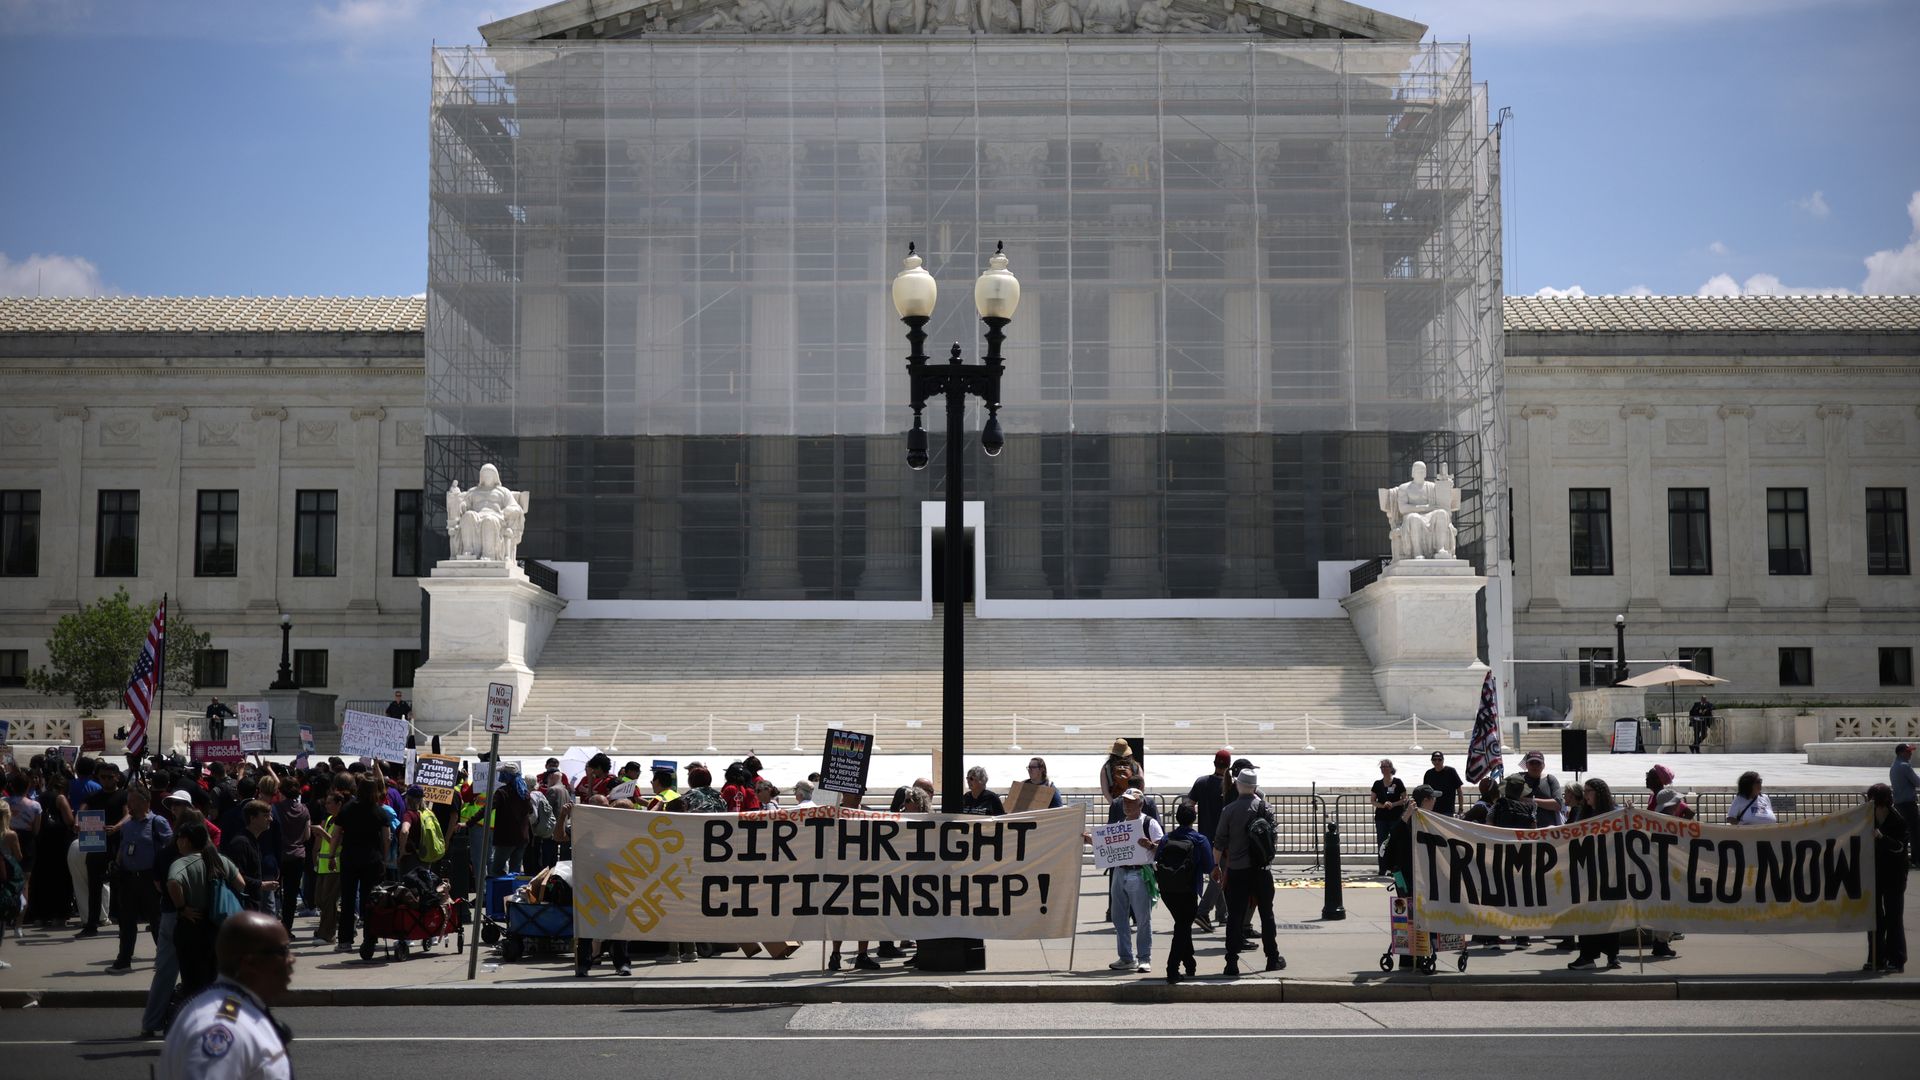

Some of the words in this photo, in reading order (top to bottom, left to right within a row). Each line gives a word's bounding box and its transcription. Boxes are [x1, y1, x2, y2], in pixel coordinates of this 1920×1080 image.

[496, 687, 505, 696] NO
[490, 696, 509, 707] PARKING
[492, 715, 503, 723] TIME
[374, 738, 405, 751] UPHOLD
[832, 731, 866, 759] NO!
[421, 763, 454, 774] Trump
[836, 762, 861, 772] Humanity
[418, 769, 455, 780] Fascist
[835, 774, 853, 782] Accept
[839, 769, 860, 777] REFUSE
[416, 776, 453, 787] Regime
[823, 777, 840, 786] Fascist
[841, 780, 862, 789] America
[1106, 824, 1134, 835] PEOPLE
[703, 817, 1037, 863] BIRTHRIGHT
[1104, 833, 1130, 845] BLEED
[1100, 845, 1136, 857] Billionaire
[1107, 851, 1134, 863] GREED
[573, 816, 685, 927] HANDS
[1417, 831, 1558, 907] TRUMP
[1568, 830, 1678, 904] MUST
[1687, 839, 1746, 903] GO
[1755, 836, 1862, 903] NOW
[701, 873, 1051, 917] CITIZENSHIP!
